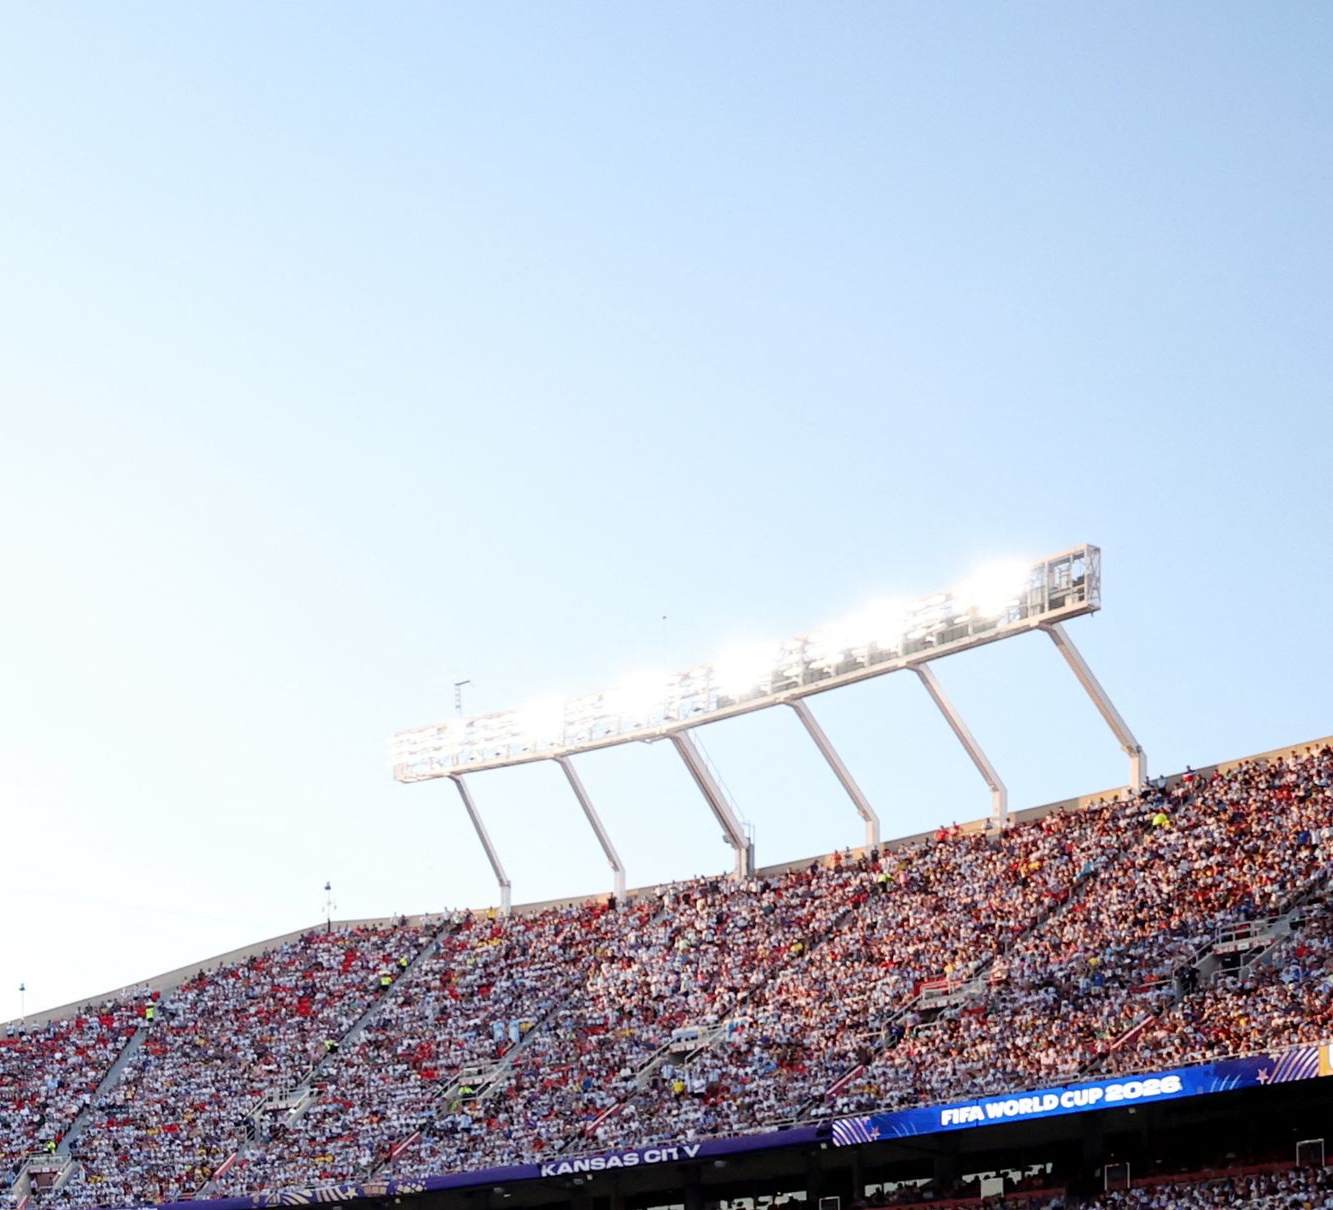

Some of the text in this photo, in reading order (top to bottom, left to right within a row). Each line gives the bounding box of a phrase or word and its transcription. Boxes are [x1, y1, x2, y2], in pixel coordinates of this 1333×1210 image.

[941, 1076, 1182, 1126] FIFA WORLD CUP 2026
[541, 1144, 701, 1177] KANSAS CITY
